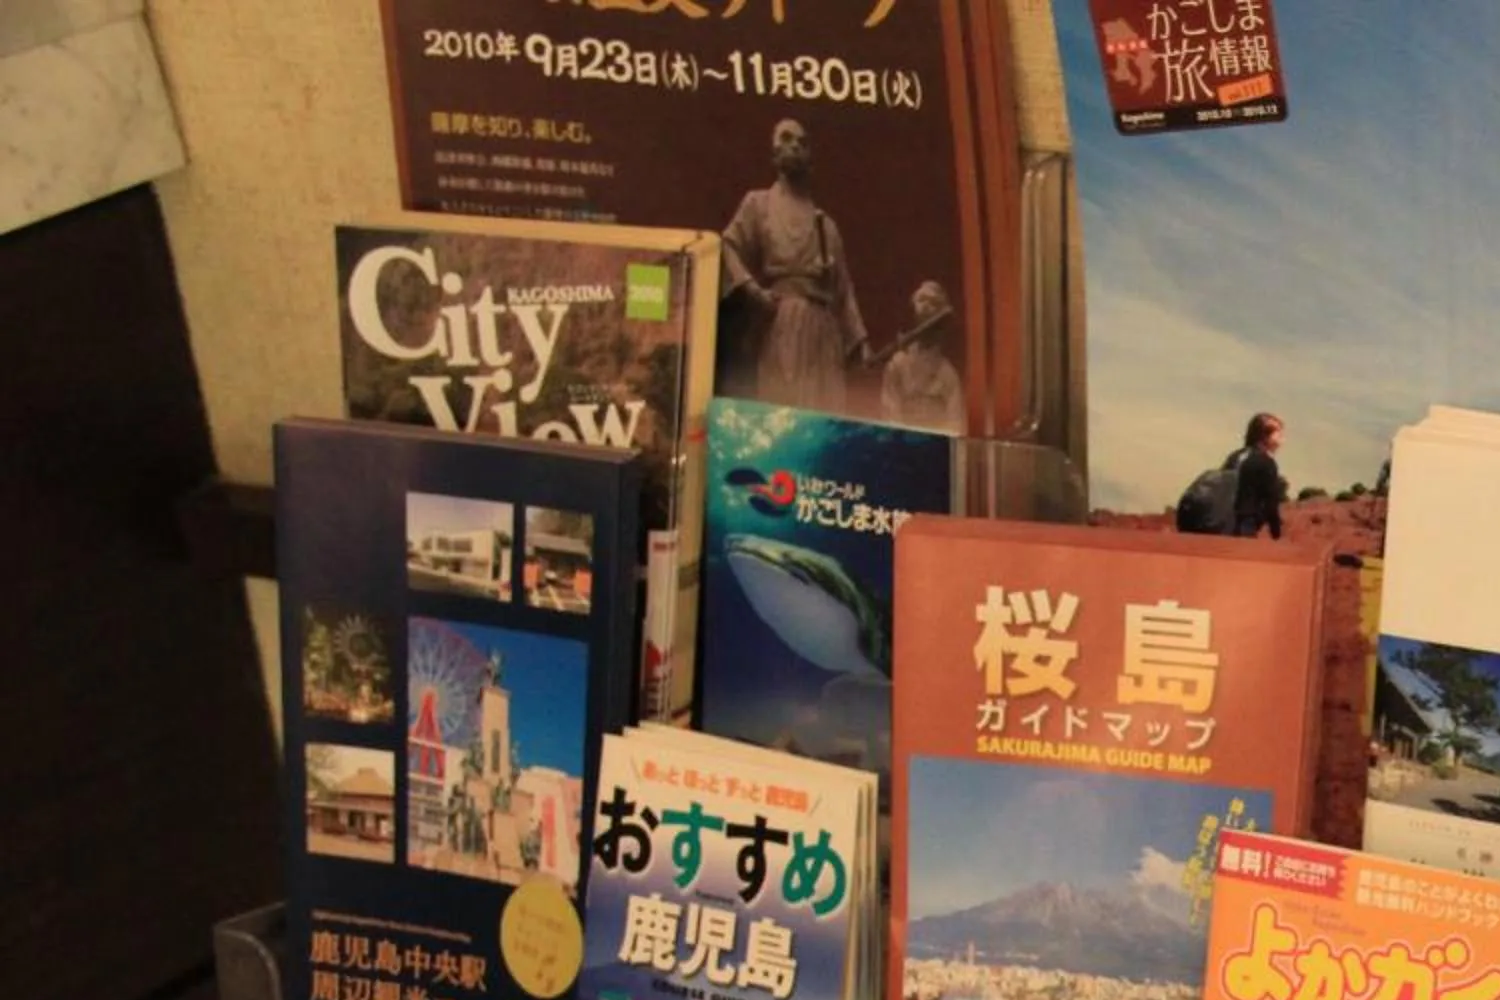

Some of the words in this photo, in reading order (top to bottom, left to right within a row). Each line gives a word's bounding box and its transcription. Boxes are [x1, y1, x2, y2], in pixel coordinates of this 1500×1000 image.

[348, 246, 569, 402] City
[508, 285, 615, 303] KAGOSHIMA
[973, 585, 1219, 712] 桜島
[975, 699, 1217, 749] ガイドマップ
[976, 735, 1100, 764] SAKURAJIMA
[1105, 749, 1164, 771] GUIDE
[1167, 755, 1212, 774] MAP
[593, 786, 847, 917] おすすめ
[1220, 844, 1271, 878] 無料!
[310, 931, 487, 991] 鹿児島中央駅
[619, 893, 797, 1000] 鹿児島
